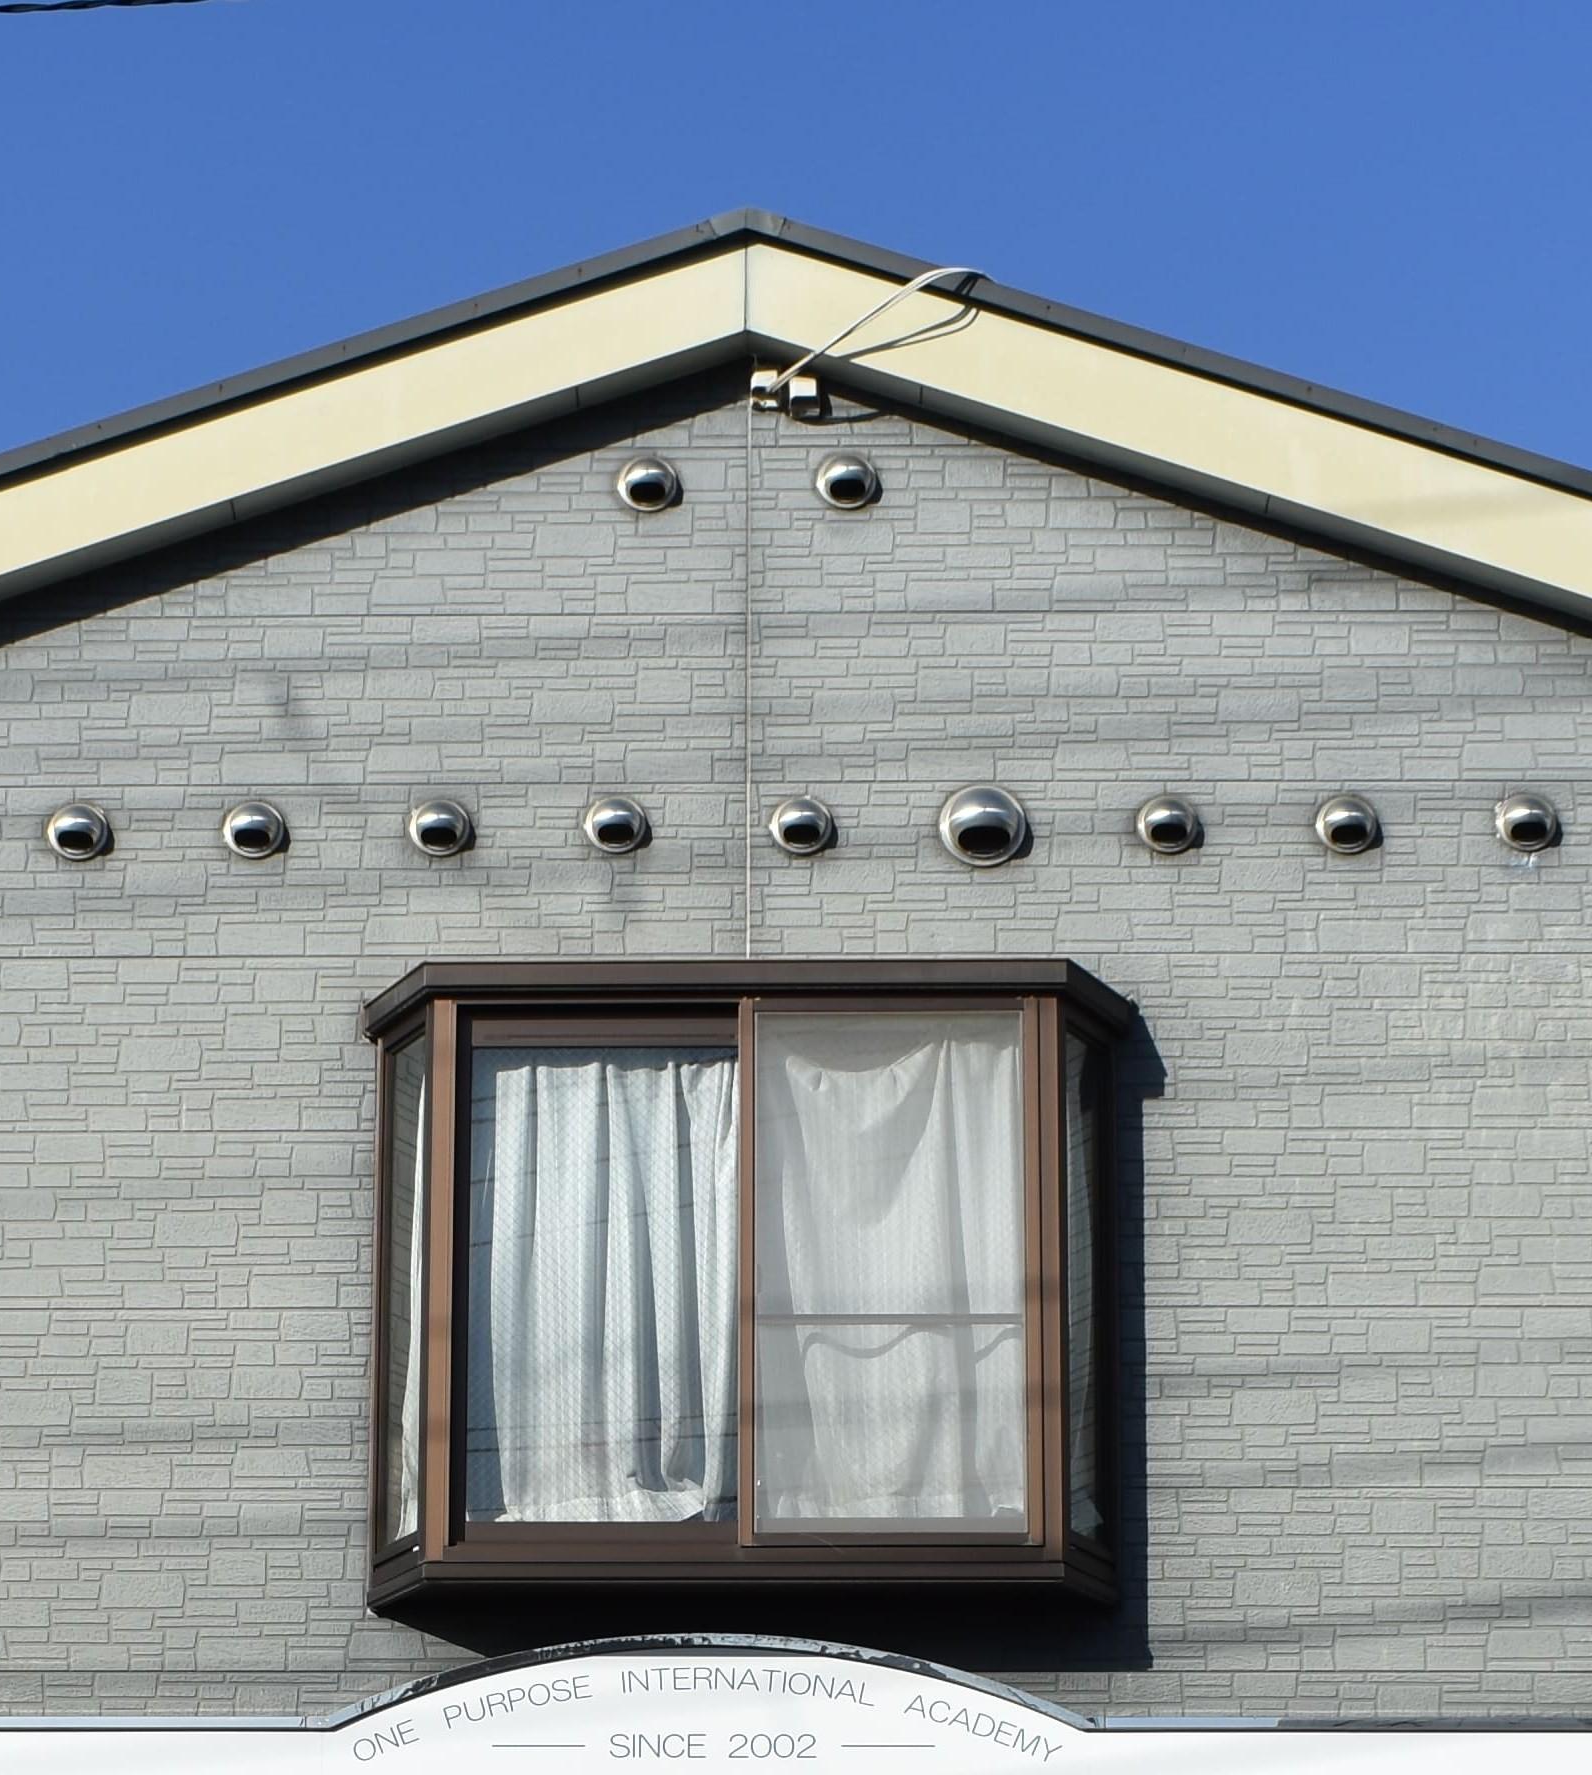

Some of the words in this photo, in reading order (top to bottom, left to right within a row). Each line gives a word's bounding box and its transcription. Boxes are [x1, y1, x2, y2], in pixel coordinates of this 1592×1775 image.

[353, 1719, 420, 1761] ONE
[442, 1674, 593, 1729] PURPOSE
[621, 1666, 875, 1707] INTERNATIONAL
[903, 1694, 1064, 1763] ACADEMY
[609, 1733, 707, 1759] SINCE
[728, 1733, 817, 1759] 2002
